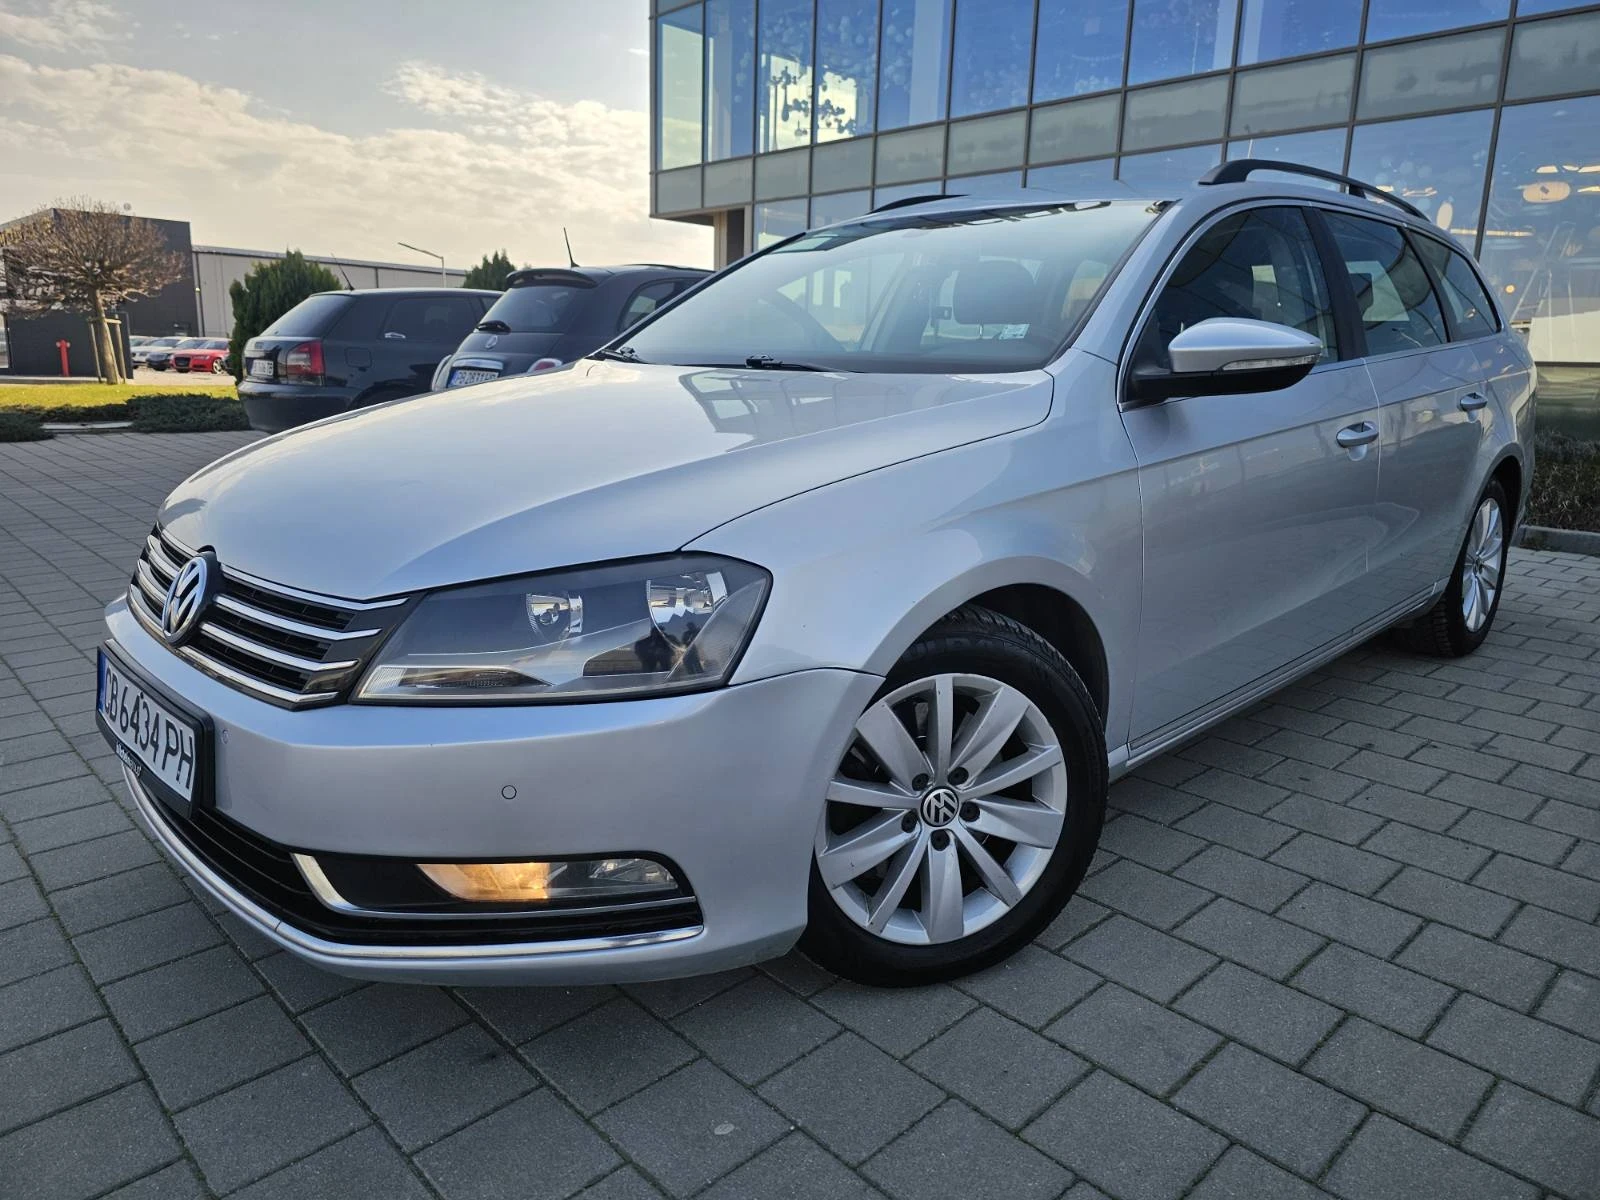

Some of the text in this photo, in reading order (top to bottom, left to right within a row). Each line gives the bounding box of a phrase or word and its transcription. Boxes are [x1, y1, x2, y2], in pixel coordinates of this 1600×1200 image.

[104, 665, 118, 722] CB
[120, 685, 160, 763] 6434
[161, 718, 195, 790] PH
